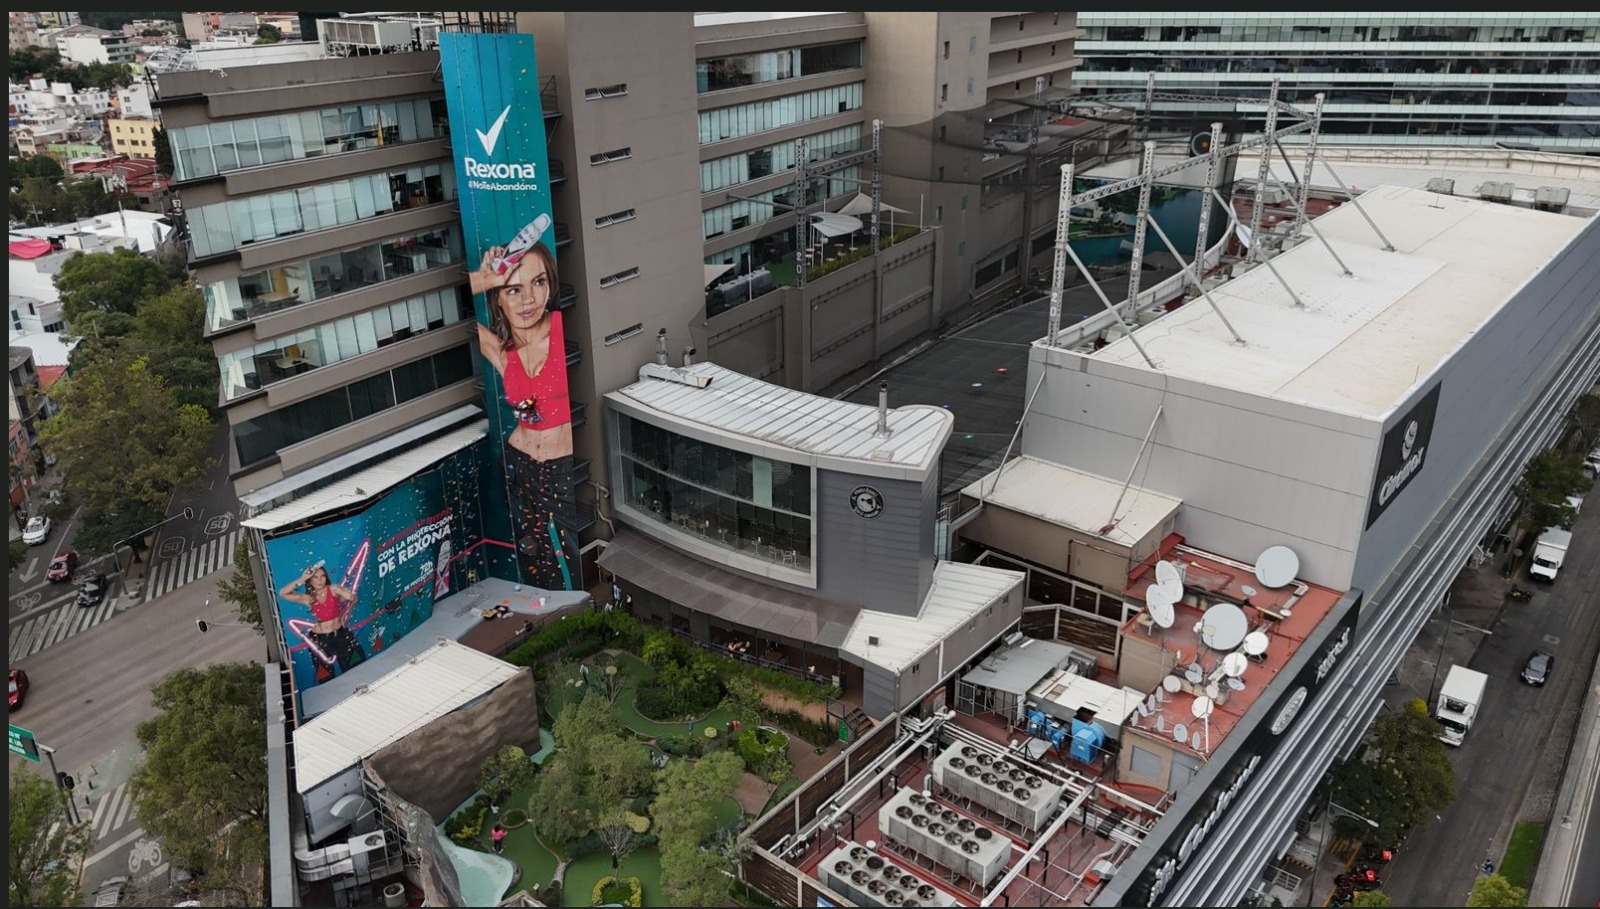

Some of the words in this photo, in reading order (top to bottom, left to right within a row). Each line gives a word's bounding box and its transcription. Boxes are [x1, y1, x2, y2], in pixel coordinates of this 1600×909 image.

[464, 157, 535, 179] Rexona
[871, 214, 877, 235] 30
[1199, 210, 1207, 233] 45
[796, 252, 802, 274] 20
[1131, 248, 1140, 272] 30
[1050, 292, 1058, 317] 20
[210, 519, 227, 528] 50
[377, 546, 395, 562] CON
[396, 541, 406, 552] LA
[378, 556, 397, 578] DE
[398, 524, 452, 565] REXONA
